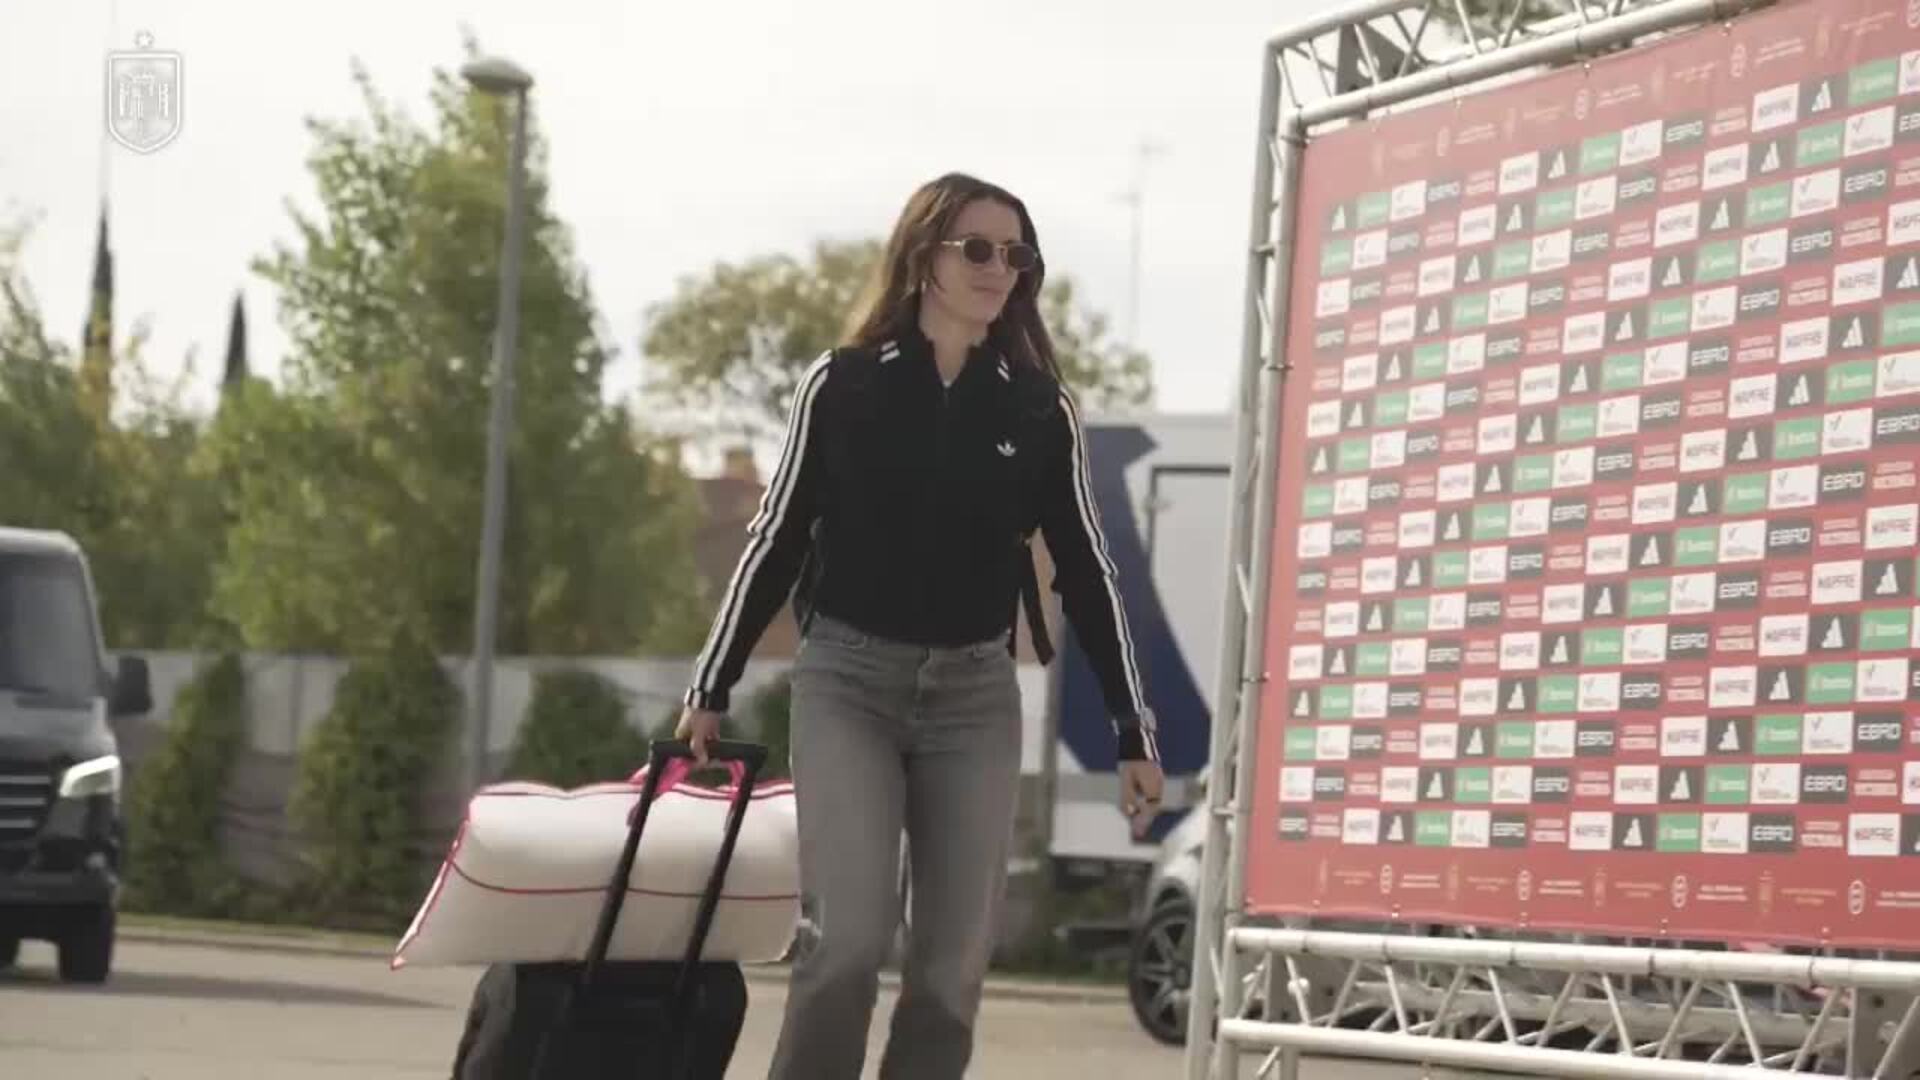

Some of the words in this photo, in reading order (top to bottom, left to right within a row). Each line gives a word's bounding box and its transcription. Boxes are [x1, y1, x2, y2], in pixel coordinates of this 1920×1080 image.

[1857, 723, 1901, 740] EBRO
[1804, 775, 1846, 791] EBRO
[1752, 825, 1793, 841] EBRO
